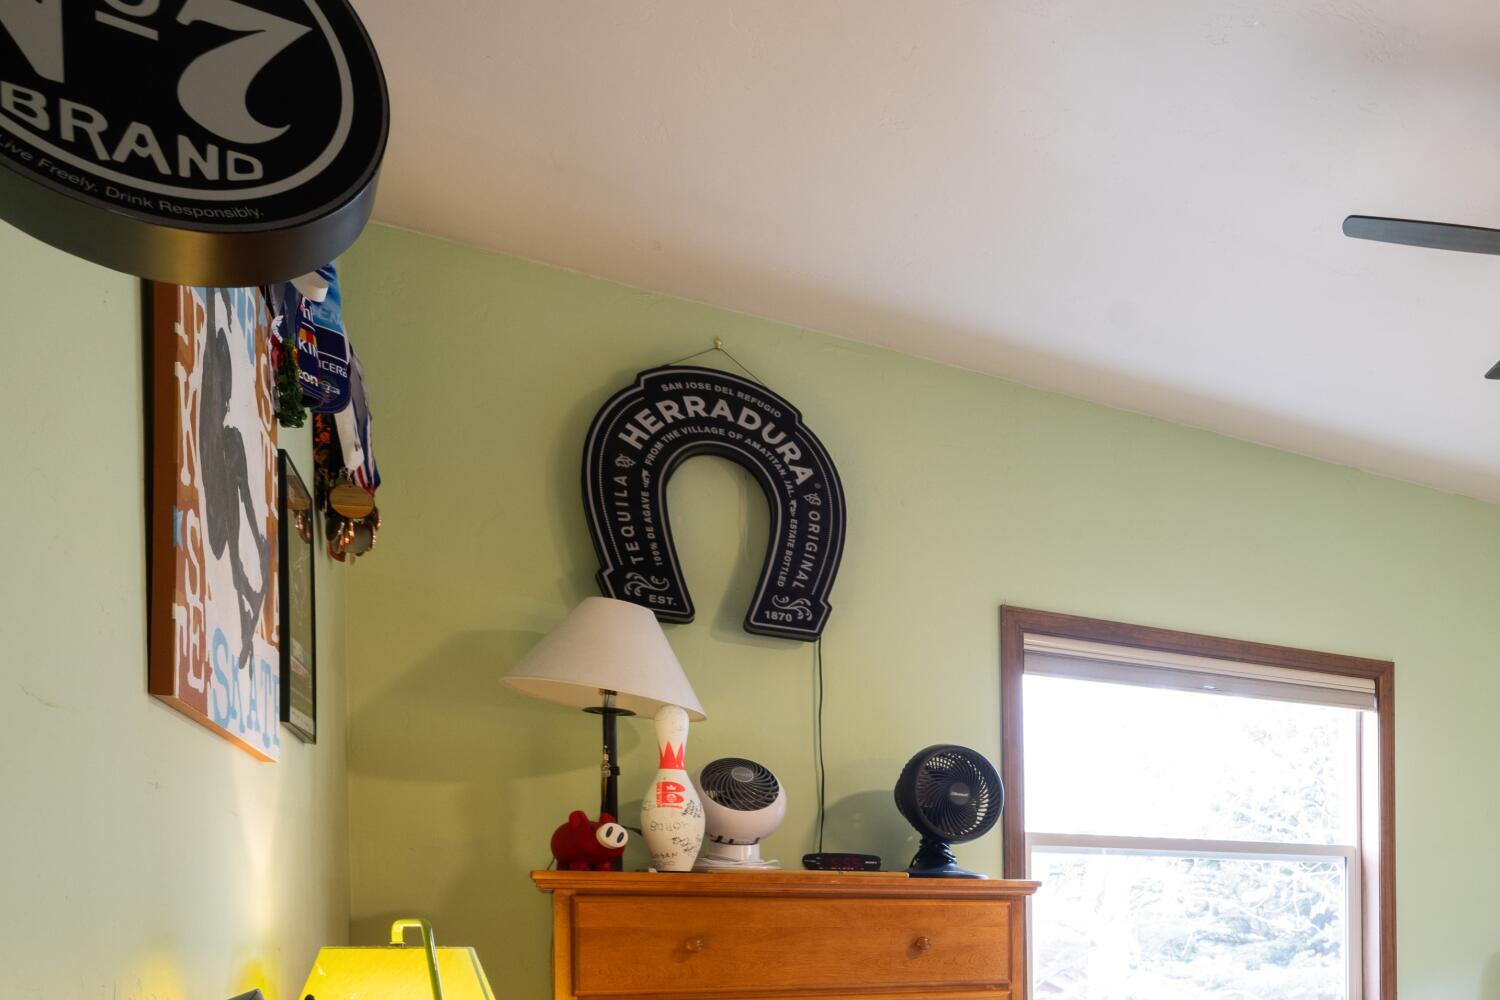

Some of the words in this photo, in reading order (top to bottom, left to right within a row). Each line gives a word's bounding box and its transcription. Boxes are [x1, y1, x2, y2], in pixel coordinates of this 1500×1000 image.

[1, 80, 264, 181] BRAND
[38, 157, 99, 193] Freely.
[105, 186, 154, 209] Drink
[159, 199, 264, 219] Responsibly.
[660, 381, 683, 392] SAN
[684, 381, 712, 391] JOSE
[714, 385, 734, 396] DEL
[737, 391, 782, 418] REFUGIO
[617, 395, 815, 487] HERRADURA
[645, 441, 664, 467] FROM
[663, 428, 681, 445] THE
[680, 425, 726, 437] VILLAGE
[727, 431, 744, 441] OF
[613, 475, 644, 565] TEQUILA
[641, 490, 651, 524] AGAVE
[787, 518, 798, 549] ESTATE
[792, 510, 822, 590] ORIGINAL
[776, 549, 794, 588] BOTTLED
[648, 593, 677, 608] EST.
[764, 609, 793, 623] 1870
